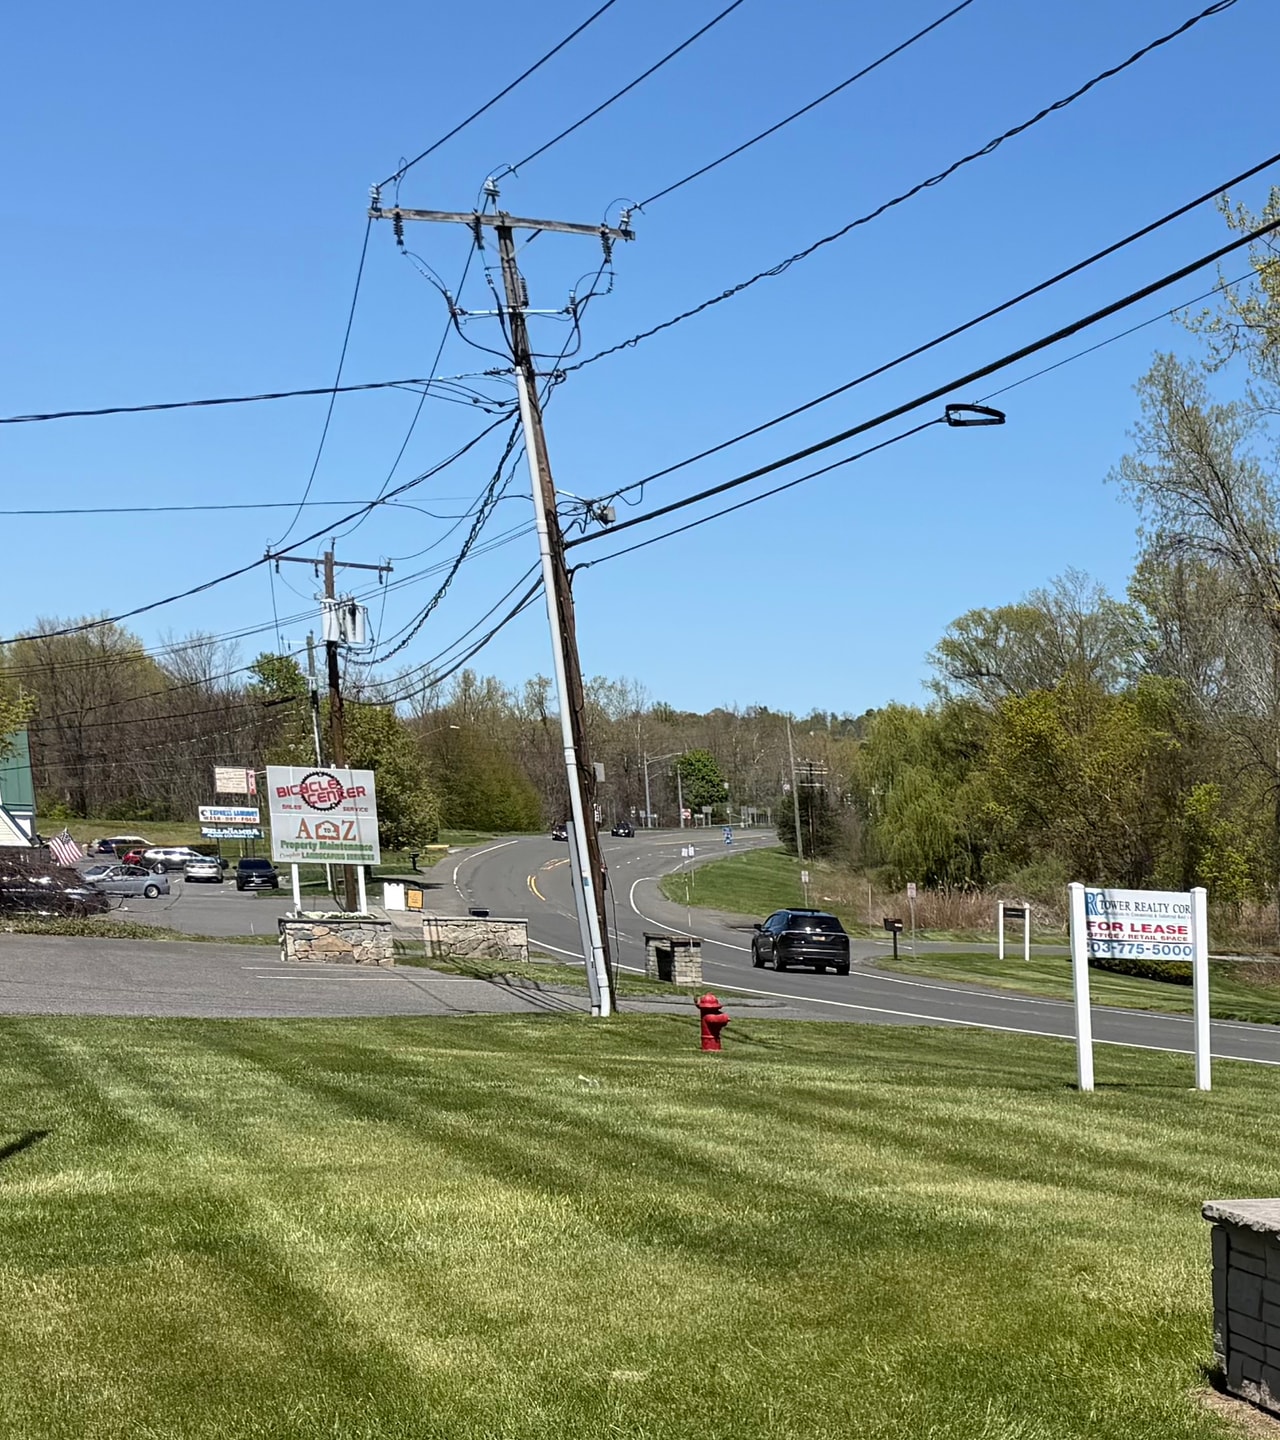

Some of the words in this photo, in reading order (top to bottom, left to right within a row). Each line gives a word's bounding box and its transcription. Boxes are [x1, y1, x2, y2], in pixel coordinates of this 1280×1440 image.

[276, 779, 338, 798] BICYCLE
[308, 786, 367, 805] CENTER
[295, 817, 314, 840] A
[341, 819, 357, 841] Z
[280, 840, 317, 851] Property
[319, 841, 374, 852] Maintenance
[1099, 900, 1131, 912] TOWER
[1134, 901, 1169, 913] REALTY
[1173, 903, 1191, 914] COR
[1087, 921, 1124, 932] FOR
[1130, 922, 1188, 935] LEASE
